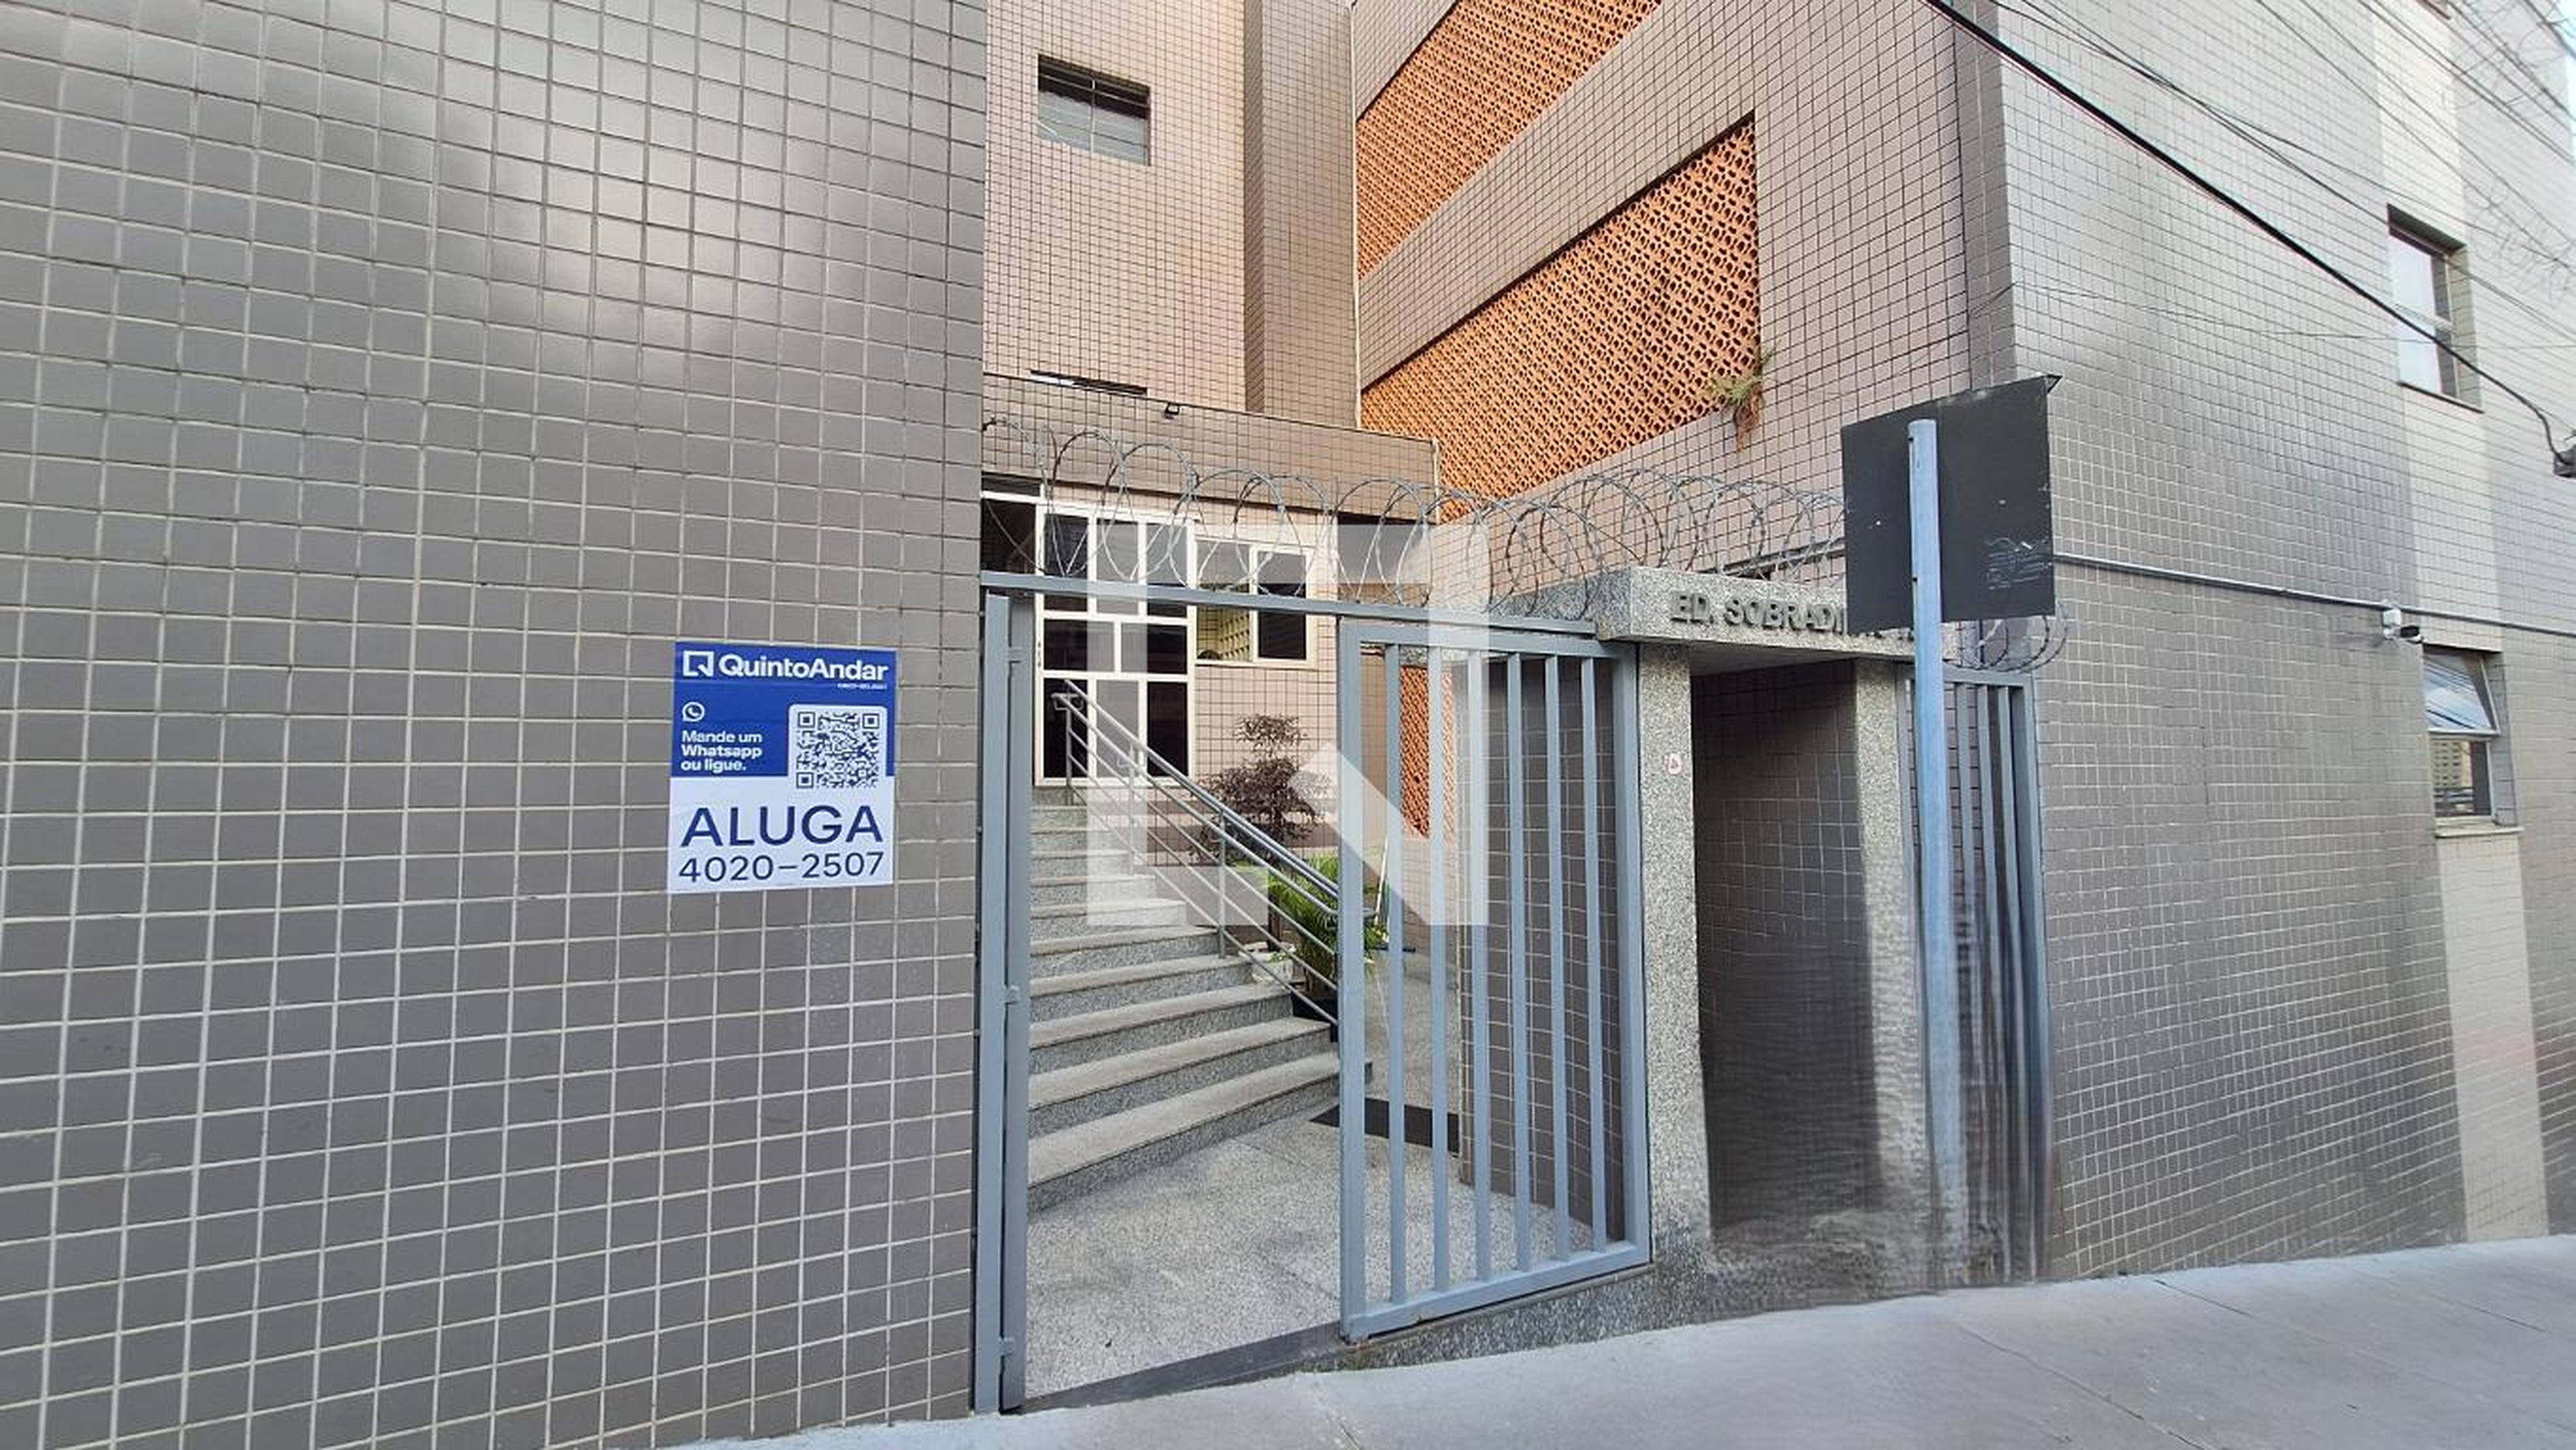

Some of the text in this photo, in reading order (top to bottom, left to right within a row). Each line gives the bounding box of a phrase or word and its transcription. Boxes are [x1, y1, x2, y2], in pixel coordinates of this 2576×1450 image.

[718, 654, 889, 680] QuintoAndar
[682, 730, 763, 743] Mande um
[681, 744, 763, 760] Whatsapp
[680, 758, 747, 774] ou ligue.
[680, 805, 883, 847] ALUGA
[679, 851, 884, 882] 4020-2507
